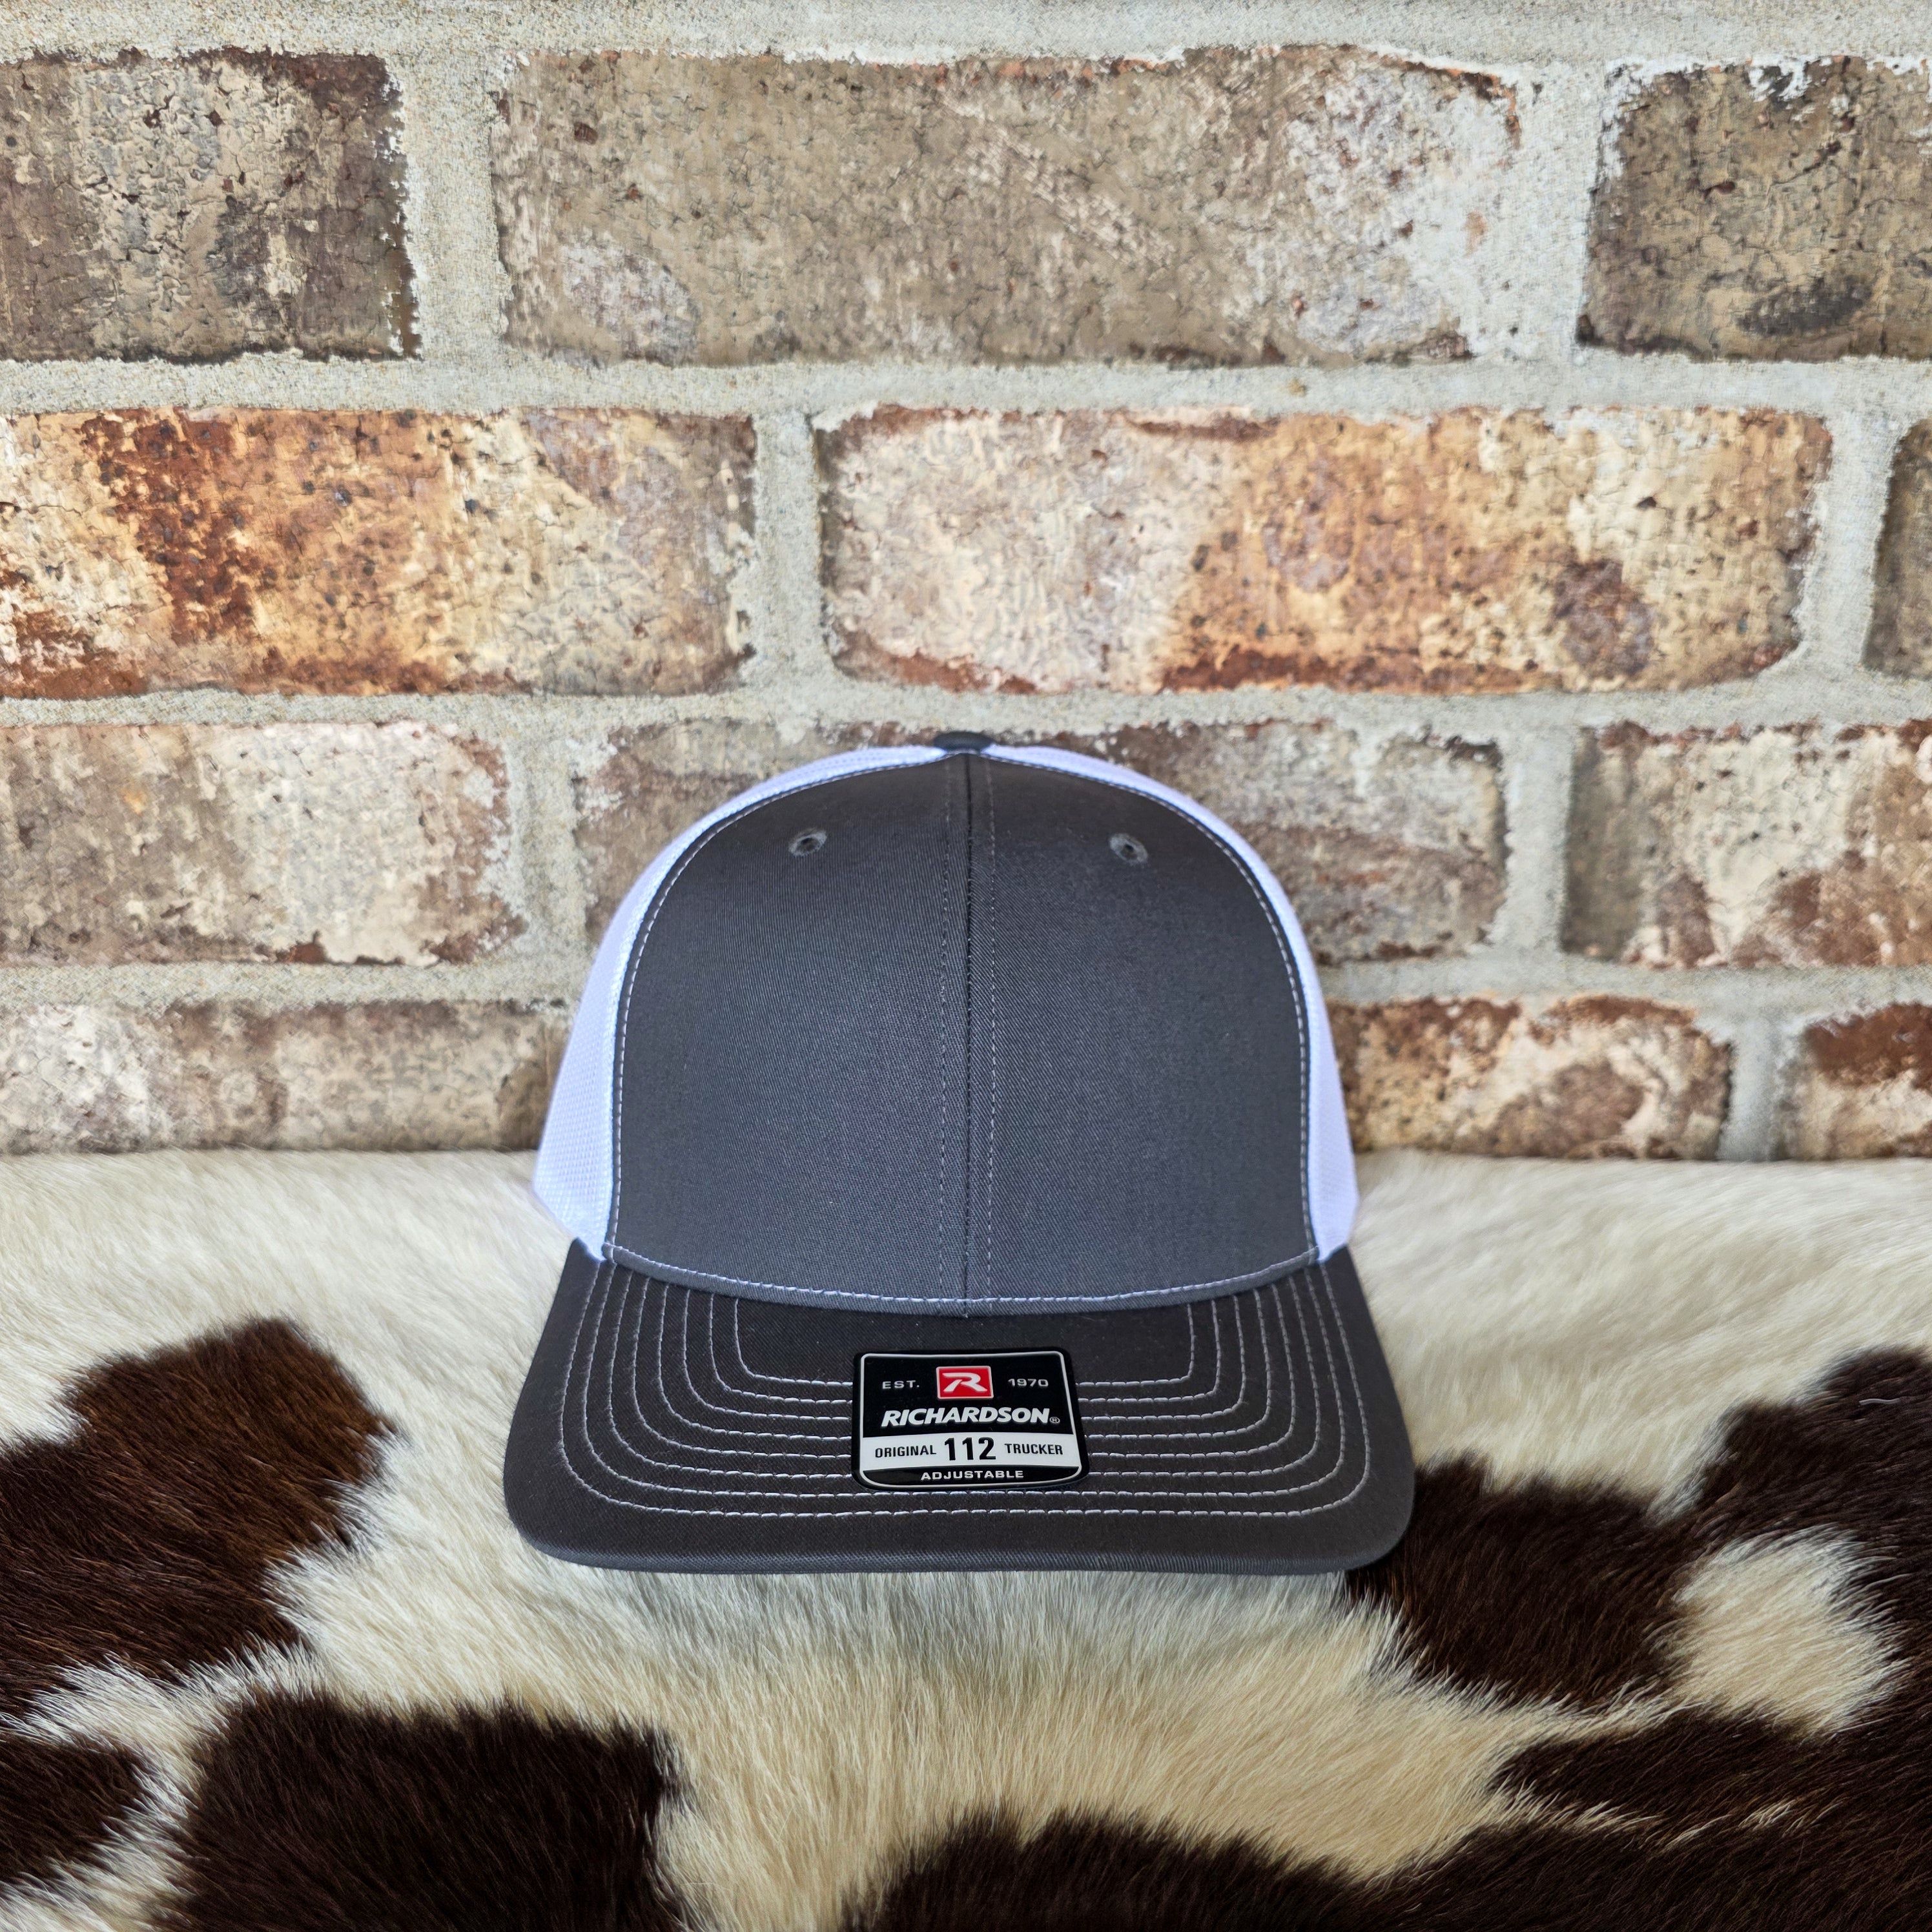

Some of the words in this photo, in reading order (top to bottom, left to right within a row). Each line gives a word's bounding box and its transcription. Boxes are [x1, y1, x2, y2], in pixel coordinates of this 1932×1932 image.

[882, 1380, 920, 1389] EST.
[942, 1372, 989, 1392] R
[1008, 1379, 1049, 1387] 1970
[875, 1445, 936, 1458] ORIGINAL
[945, 1437, 996, 1461] 112
[1005, 1443, 1063, 1455] TRUCKER
[921, 1470, 1024, 1481] ADJUSTABLE
